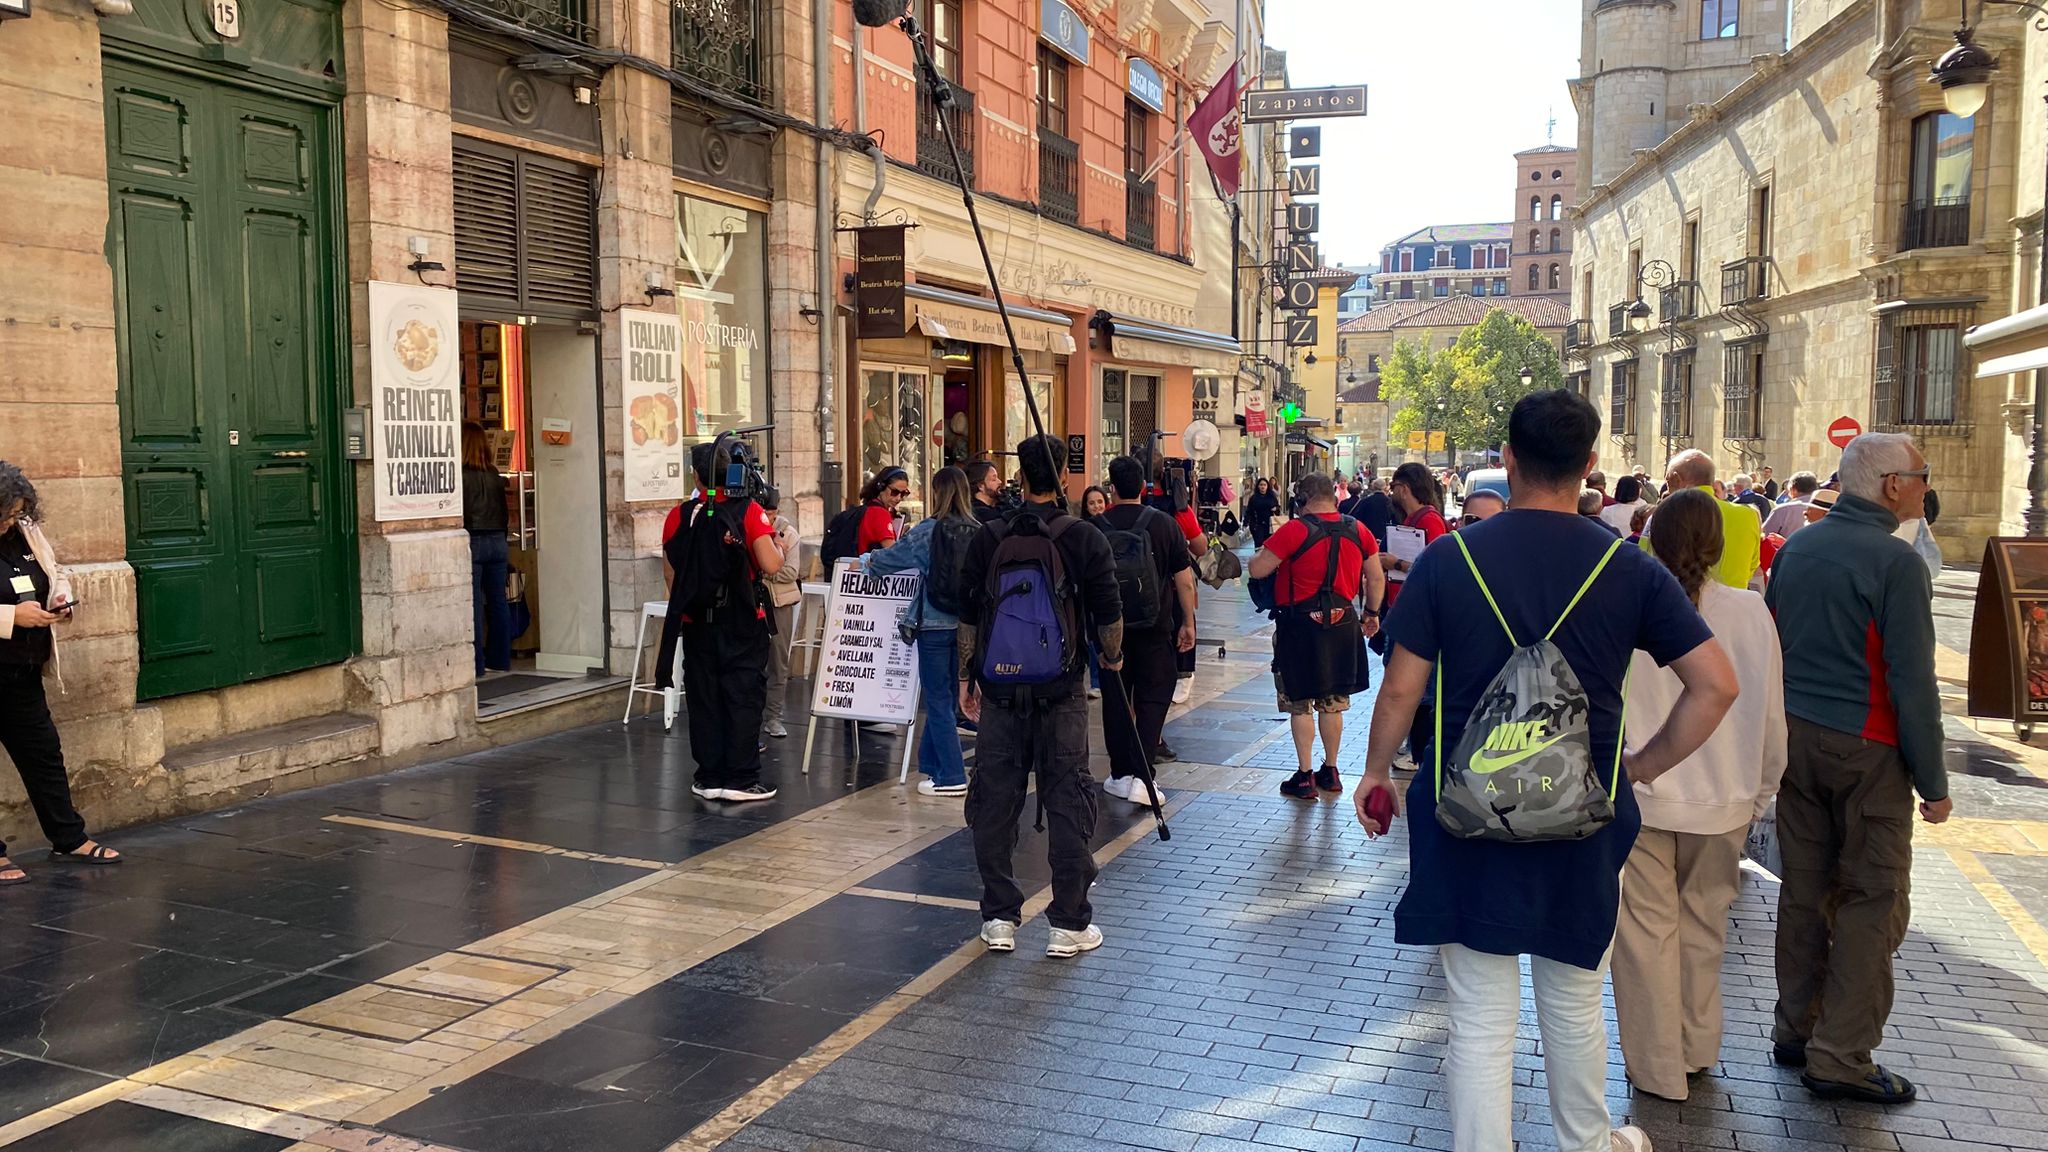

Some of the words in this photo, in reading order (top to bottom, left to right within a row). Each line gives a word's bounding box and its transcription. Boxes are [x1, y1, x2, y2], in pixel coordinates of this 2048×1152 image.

[217, 2, 234, 24] 15
[1258, 95, 1354, 111] zapatos
[860, 254, 902, 262] Sombrerería
[1291, 168, 1318, 345] MUÑOZ
[881, 307, 896, 315] shop
[629, 320, 676, 352] ITALIAN
[630, 350, 676, 383] ROLL
[383, 386, 455, 422] REINETA
[384, 425, 455, 458] VAINILLA
[387, 462, 395, 496] Y
[397, 460, 455, 496] CARAMELO
[844, 603, 864, 616] NATA
[843, 618, 875, 632] VAINILLA
[839, 634, 869, 648] CARAMELO
[873, 637, 884, 649] SAL
[836, 650, 874, 664] AVELLANA
[834, 665, 876, 680] CHOCOLATE
[831, 680, 855, 694] FRESA
[829, 695, 853, 709] LIMÓN
[1484, 719, 1548, 751] NIKE
[1484, 776, 1553, 795] AIR
